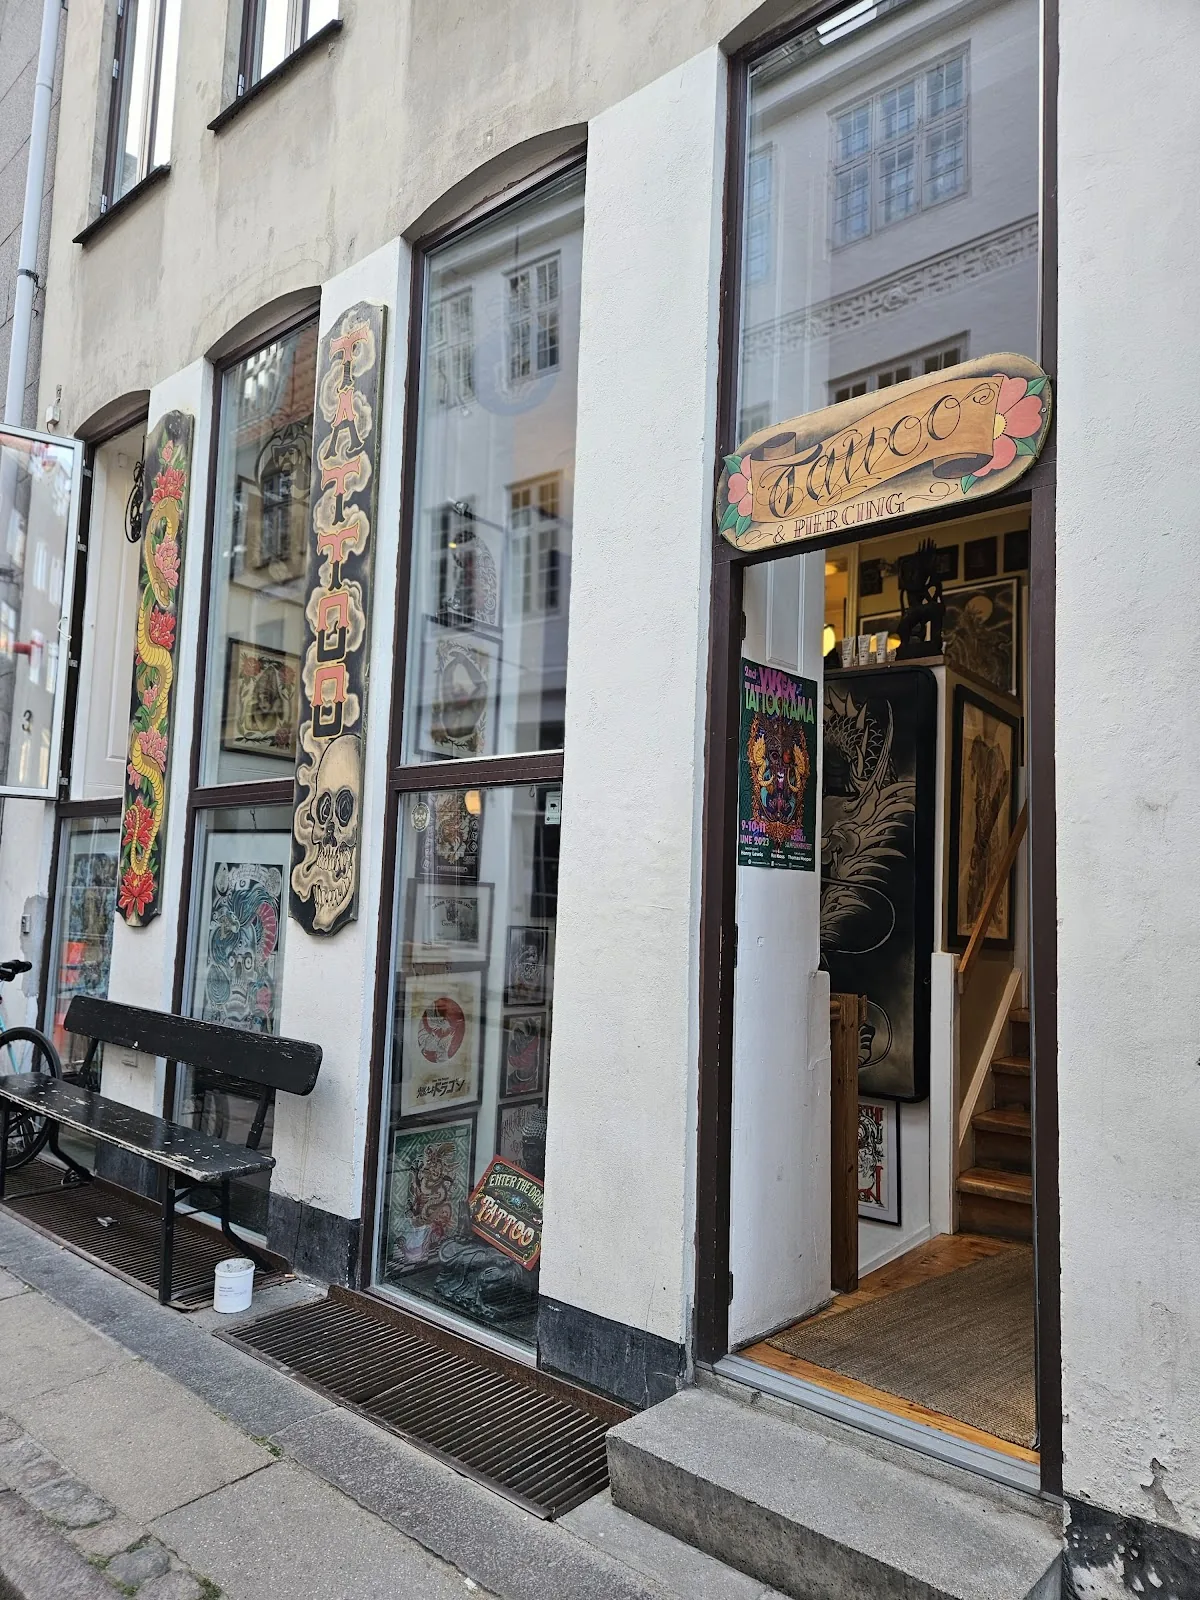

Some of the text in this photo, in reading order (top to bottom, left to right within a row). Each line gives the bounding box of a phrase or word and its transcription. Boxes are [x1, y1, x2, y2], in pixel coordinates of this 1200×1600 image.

[311, 322, 369, 740] TATTOO
[773, 493, 906, 544] & PIERCING
[744, 681, 815, 725] TATTOORAMA
[754, 836, 770, 847] 2023
[489, 1174, 517, 1190] ENTER
[515, 1177, 533, 1194] THE
[475, 1194, 535, 1248] TATTOO
